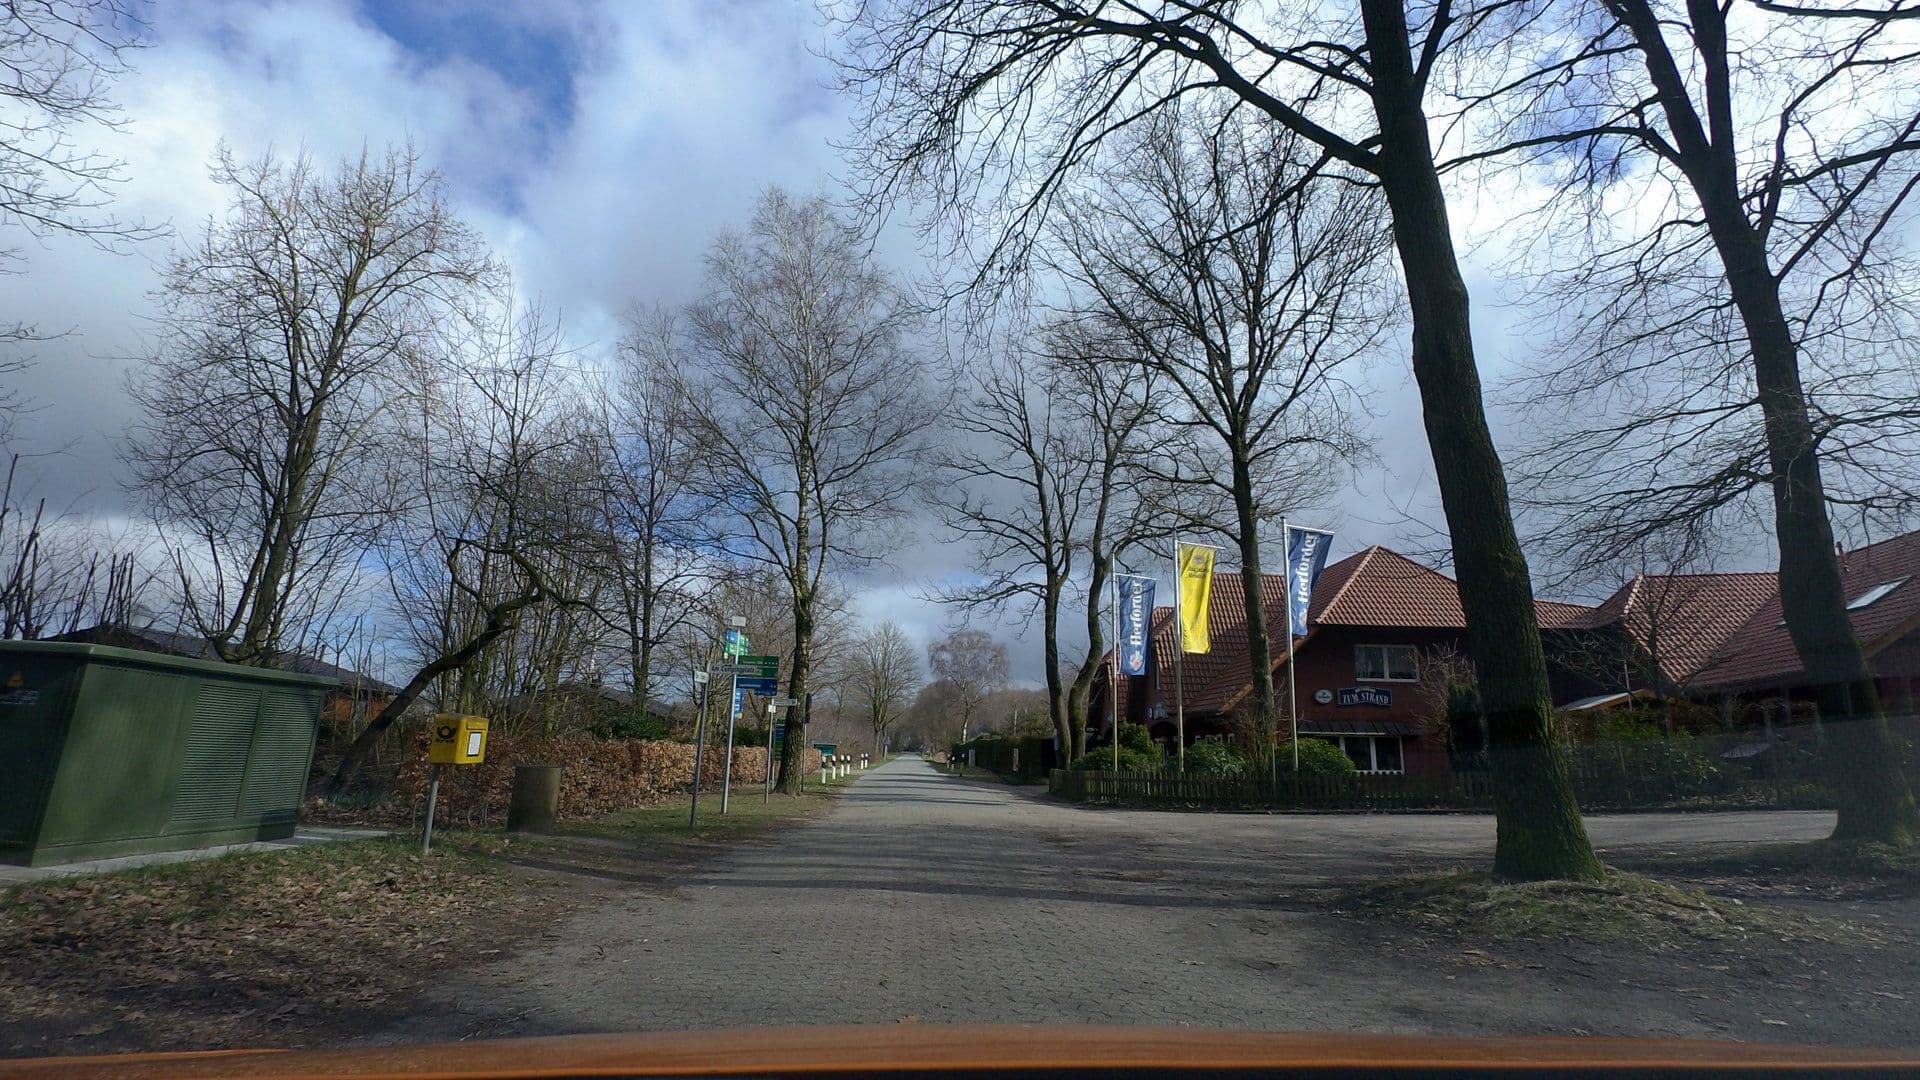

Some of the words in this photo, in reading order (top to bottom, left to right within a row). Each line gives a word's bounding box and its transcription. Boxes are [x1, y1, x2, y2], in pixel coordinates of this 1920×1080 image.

[1296, 533, 1317, 603] Herforder
[1130, 579, 1143, 646] Herforder
[1360, 691, 1389, 704] STRAND
